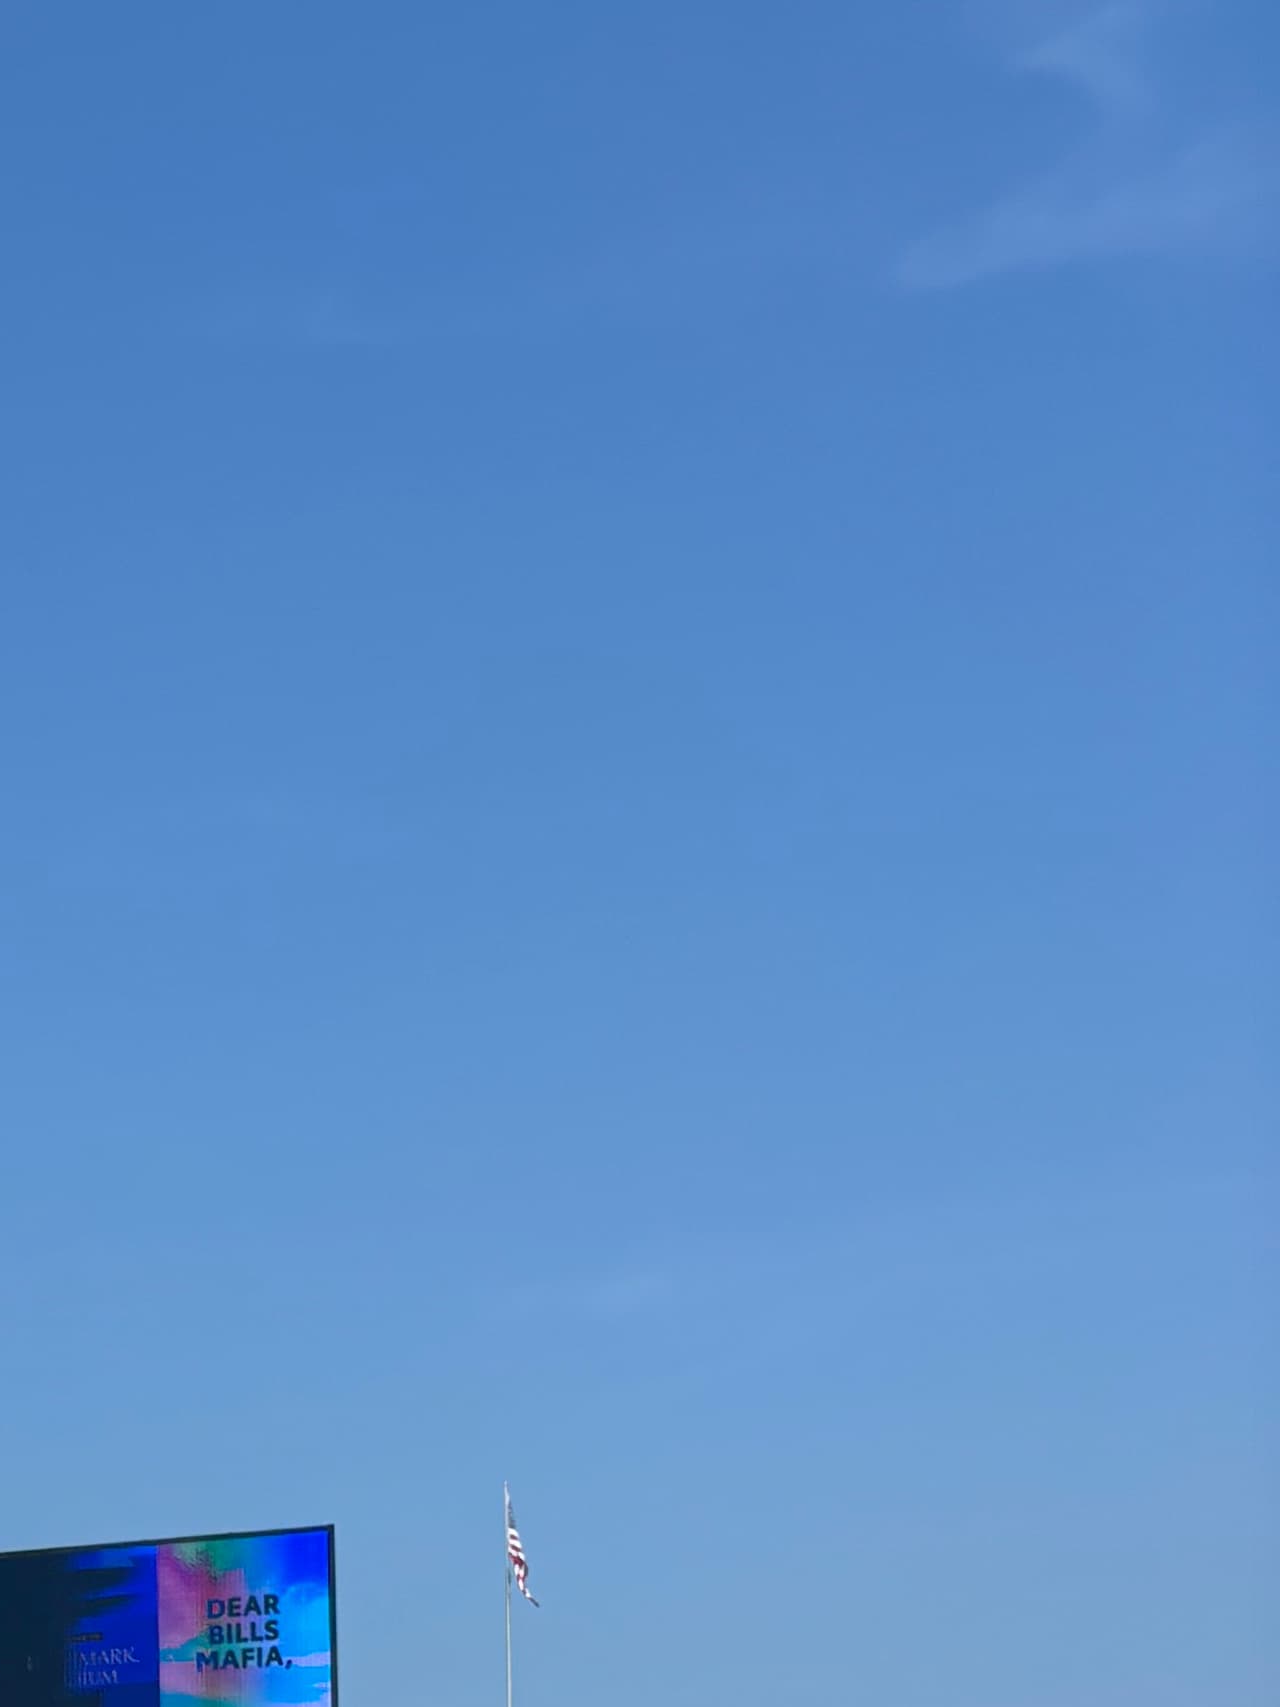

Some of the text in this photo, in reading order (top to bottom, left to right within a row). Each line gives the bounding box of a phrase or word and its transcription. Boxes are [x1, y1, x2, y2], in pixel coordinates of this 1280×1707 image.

[207, 1594, 280, 1619] DEAR
[208, 1620, 279, 1645] BILLS
[196, 1646, 292, 1672] MAFIA,
